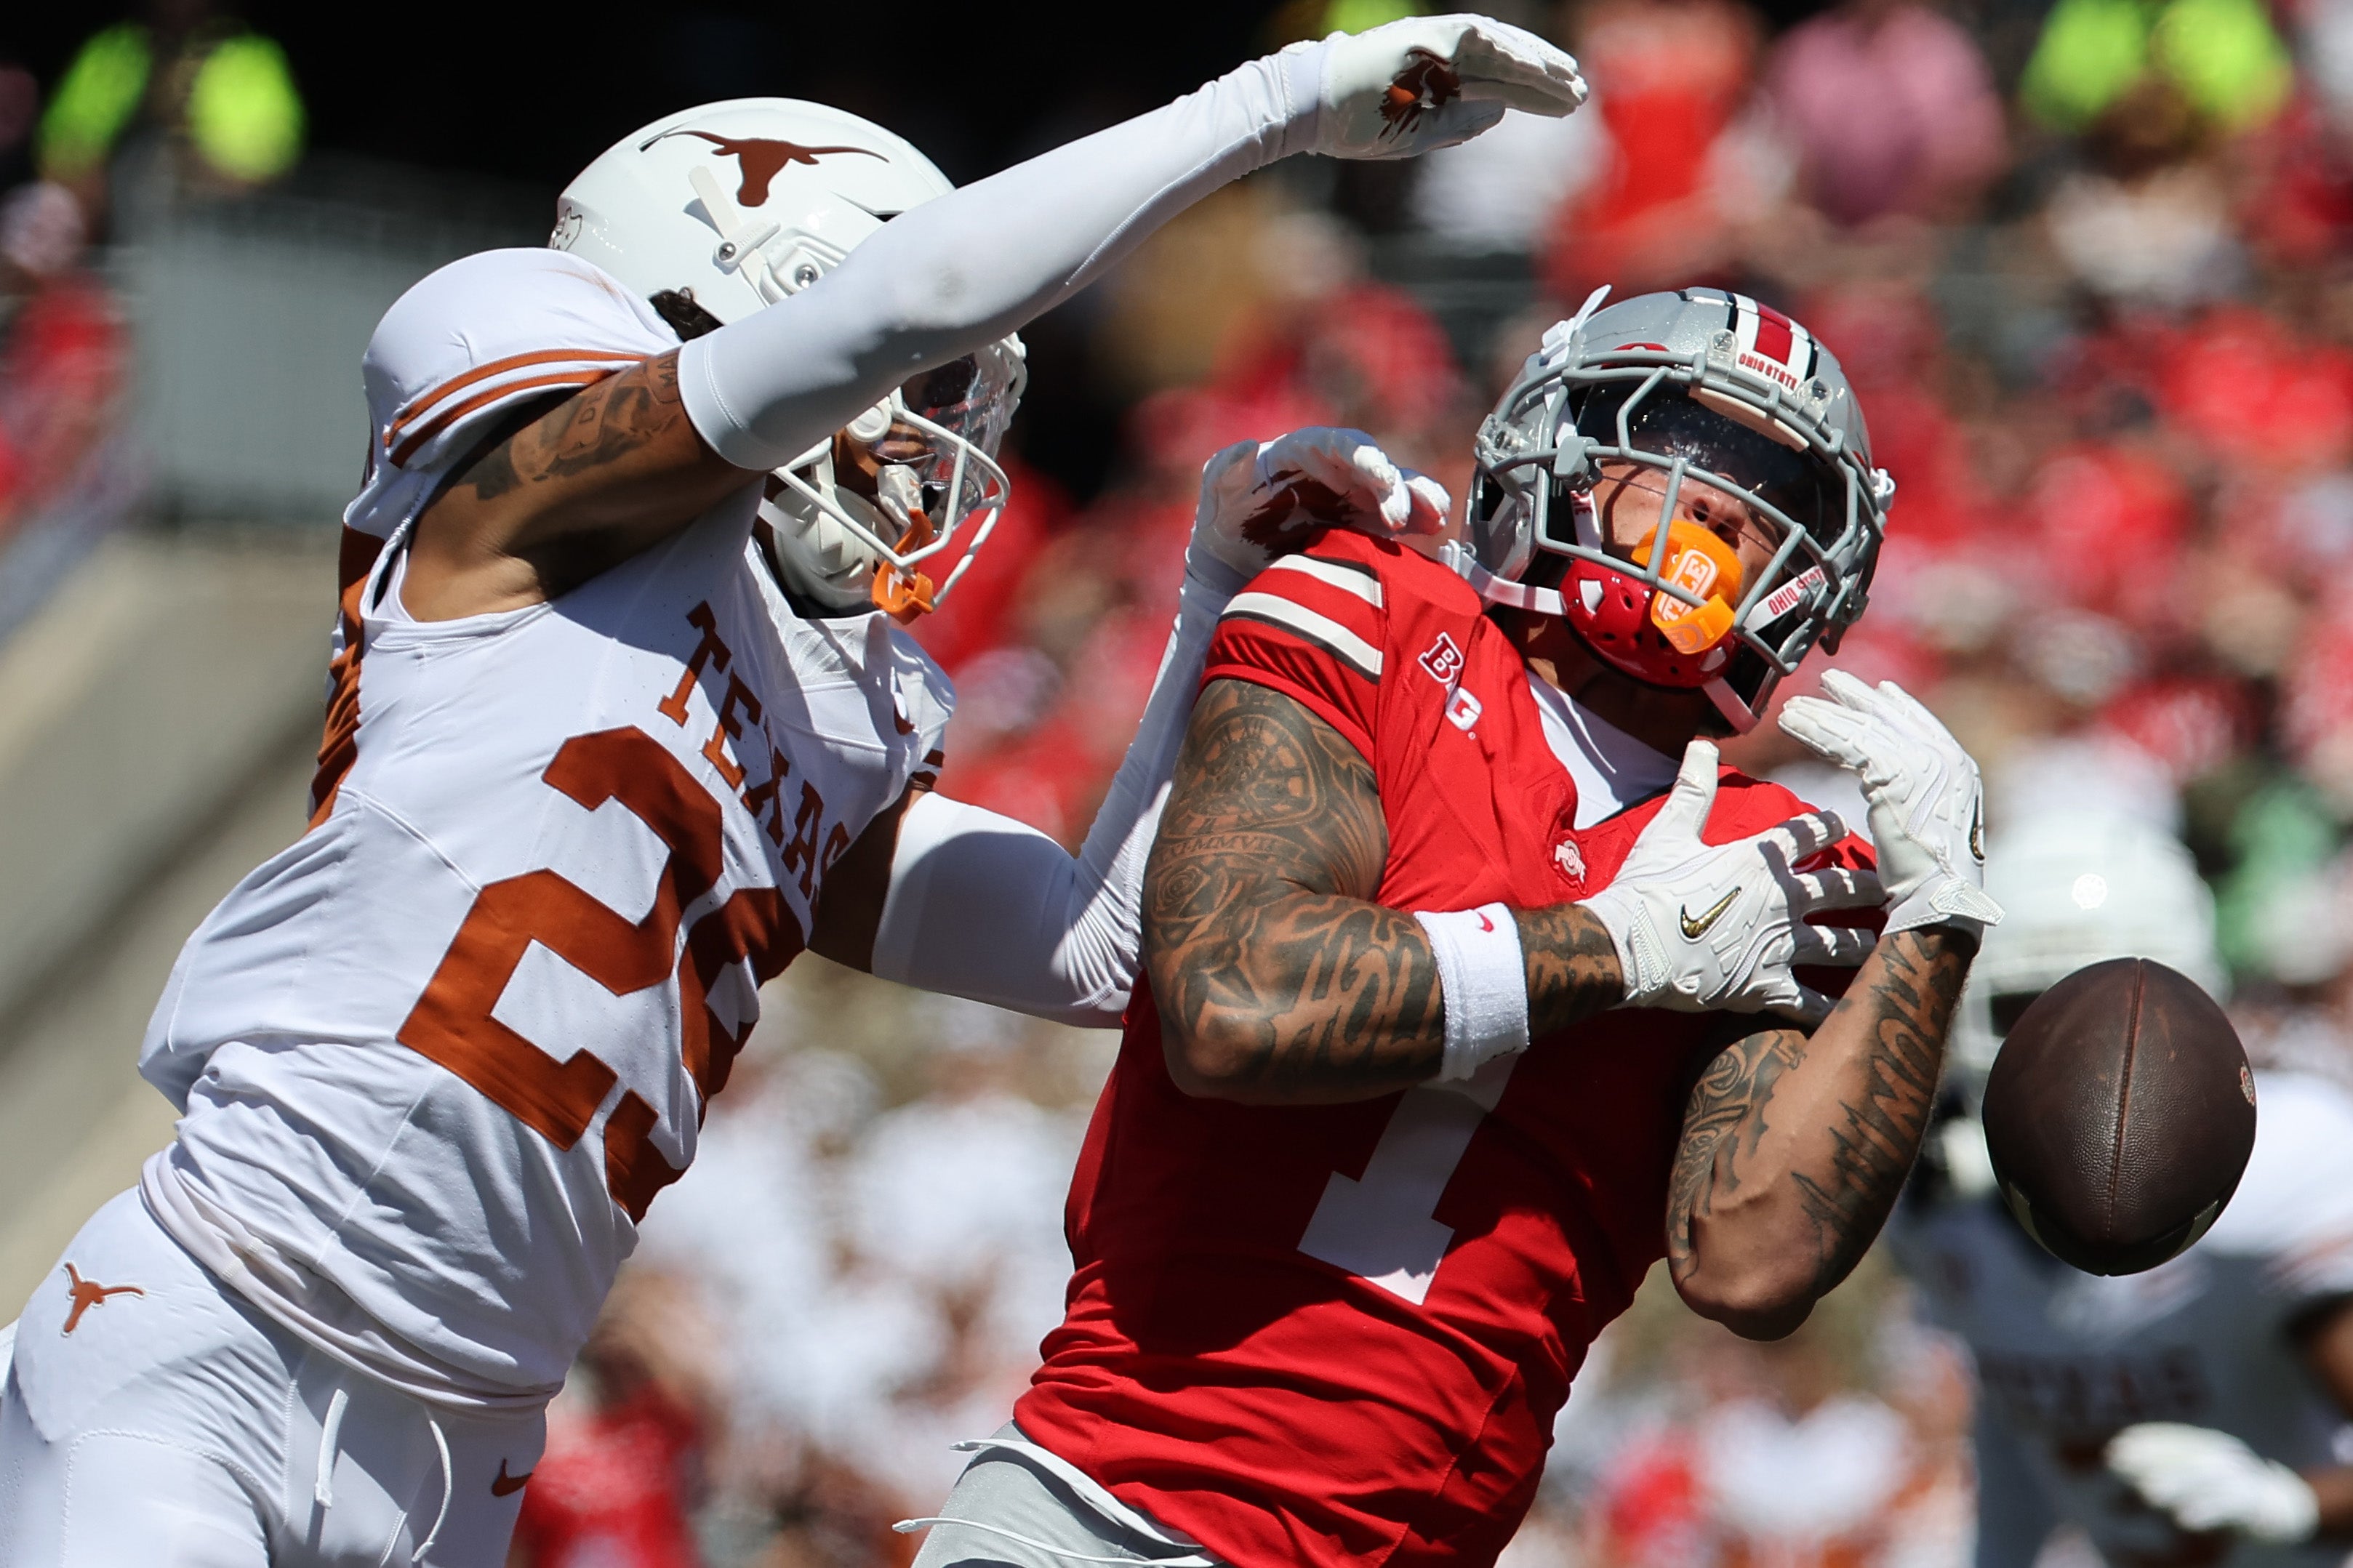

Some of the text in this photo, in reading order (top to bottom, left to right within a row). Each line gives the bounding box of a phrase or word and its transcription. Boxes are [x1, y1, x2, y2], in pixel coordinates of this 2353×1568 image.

[1739, 352, 1797, 391] OHIO STATE
[1768, 586, 1800, 616] OHIO
